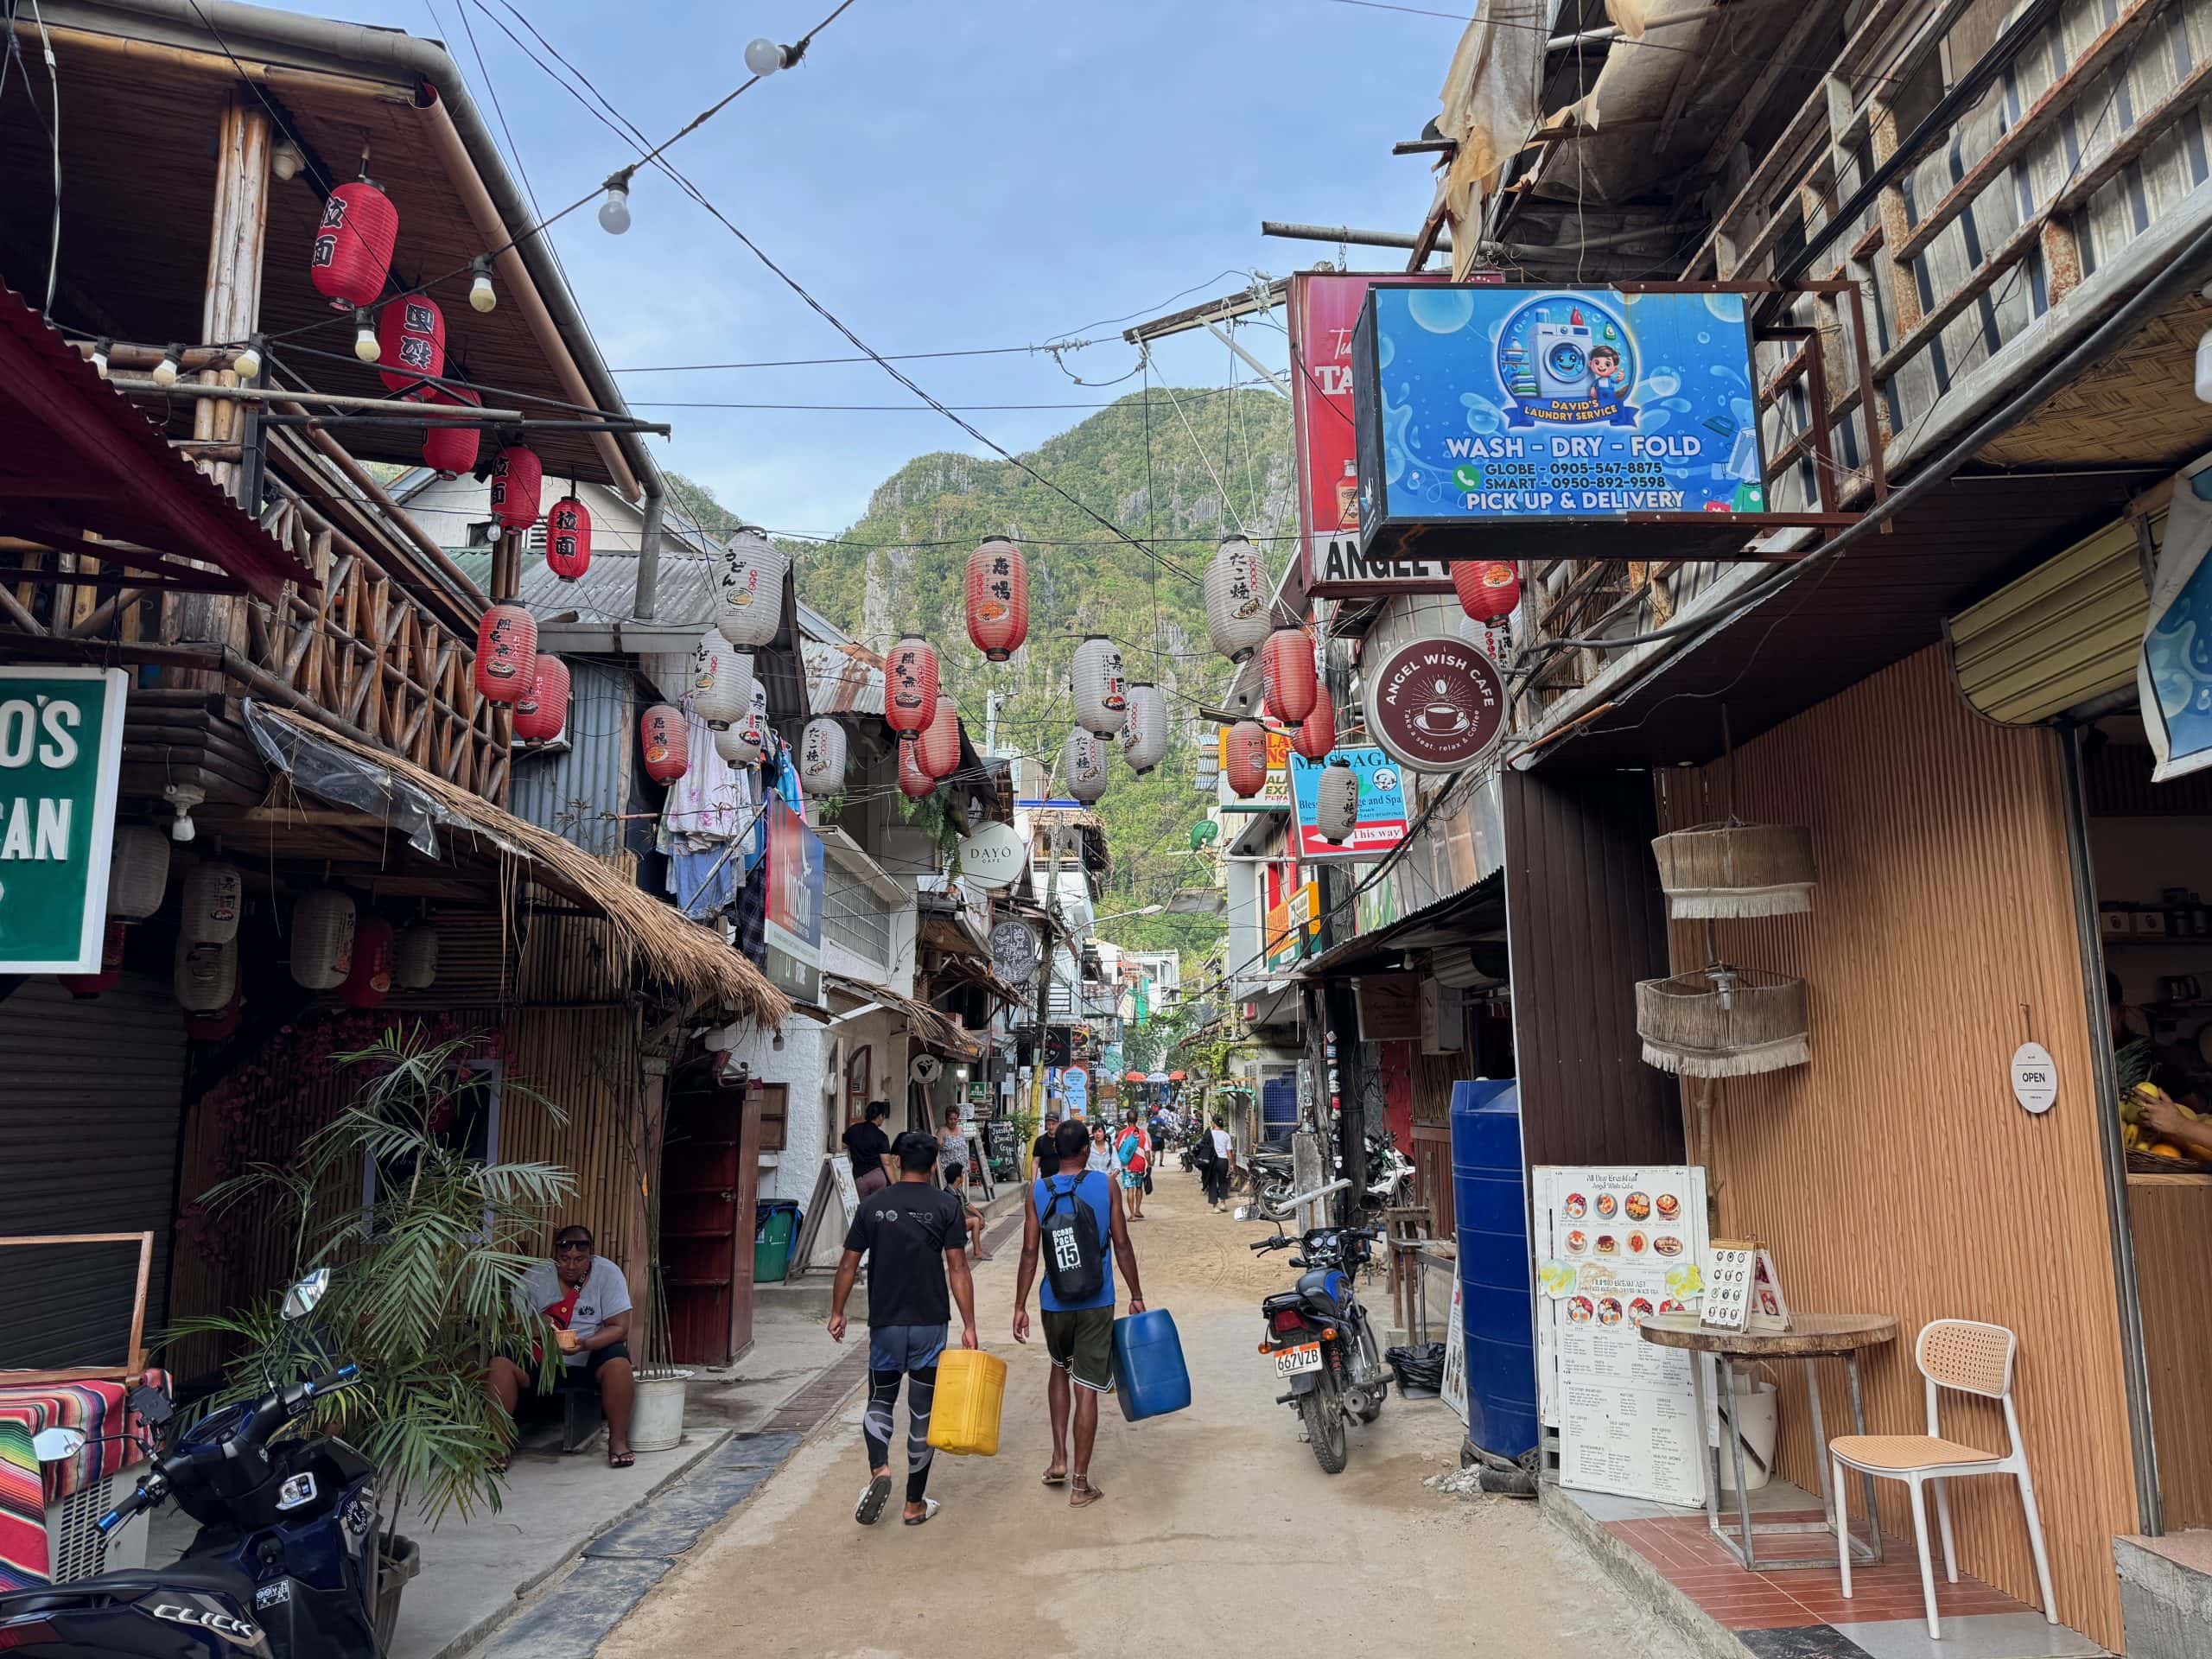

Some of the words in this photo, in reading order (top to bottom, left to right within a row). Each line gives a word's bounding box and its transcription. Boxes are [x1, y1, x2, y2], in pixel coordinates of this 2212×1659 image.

[1524, 406, 1573, 421] LAUNDRY
[1576, 404, 1618, 421] SERVICE
[1551, 399, 1599, 410] DAVID'S
[1446, 436, 1524, 458] WASH
[1550, 436, 1604, 457] DRY
[1630, 436, 1702, 457] FOLD
[1485, 464, 1535, 474] GLOBE
[1549, 462, 1662, 474] 0905-547-8875
[1485, 478, 1536, 489] SMART
[1551, 476, 1665, 489] 0950-892-9598
[1466, 493, 1518, 510] PICK
[1523, 493, 1554, 510] UP
[1560, 492, 1577, 509] &
[1582, 491, 1685, 510] DELIVERY
[554, 510, 580, 557] 拉面
[1385, 661, 1421, 706] ANGEL
[1423, 654, 1468, 671] WISH
[1469, 669, 1495, 707] CAFE
[1439, 742, 1462, 752] relax
[1368, 794, 1383, 805] and
[1385, 792, 1402, 806] Spa
[0, 797, 73, 861] AN
[1354, 829, 1376, 839] This
[1380, 828, 1401, 839] way
[784, 844, 811, 928] Winston
[2022, 1072, 2046, 1083] OPEN
[1057, 1245, 1079, 1268] 15
[1277, 1349, 1319, 1370] 667VZB
[153, 1604, 252, 1637] CLICK
